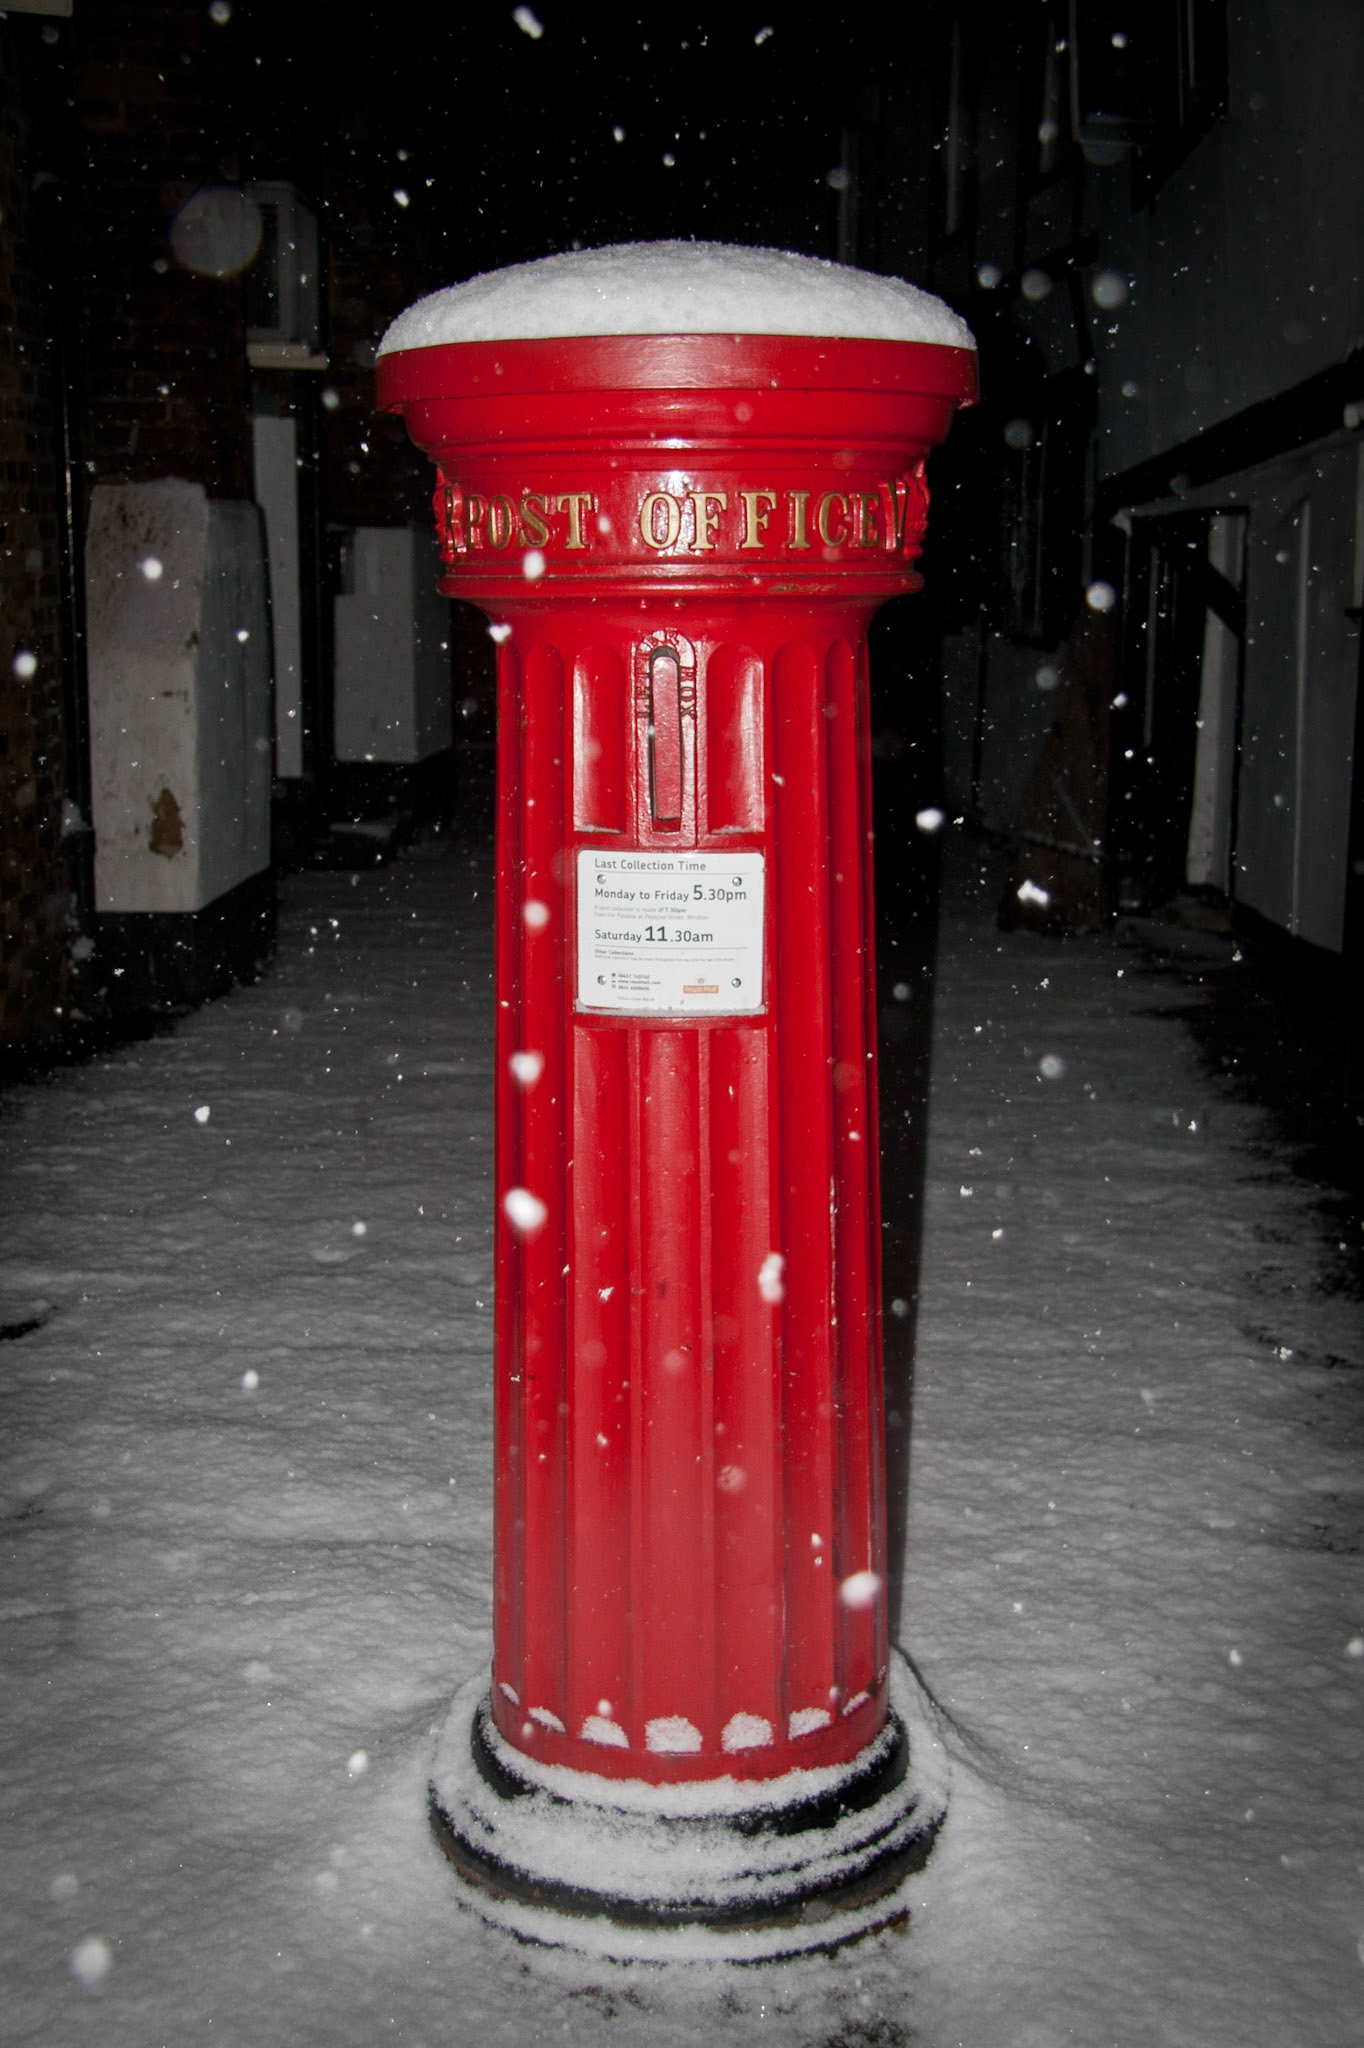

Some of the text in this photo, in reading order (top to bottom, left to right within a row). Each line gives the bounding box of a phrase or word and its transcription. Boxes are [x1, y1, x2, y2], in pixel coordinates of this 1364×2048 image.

[464, 491, 882, 551] POST OFFICE
[680, 666, 695, 720] BOX
[594, 858, 707, 872] Last Collection Time
[594, 884, 747, 903] Monday to Friday 5.30pm
[594, 925, 713, 943] Saturday 11.30am
